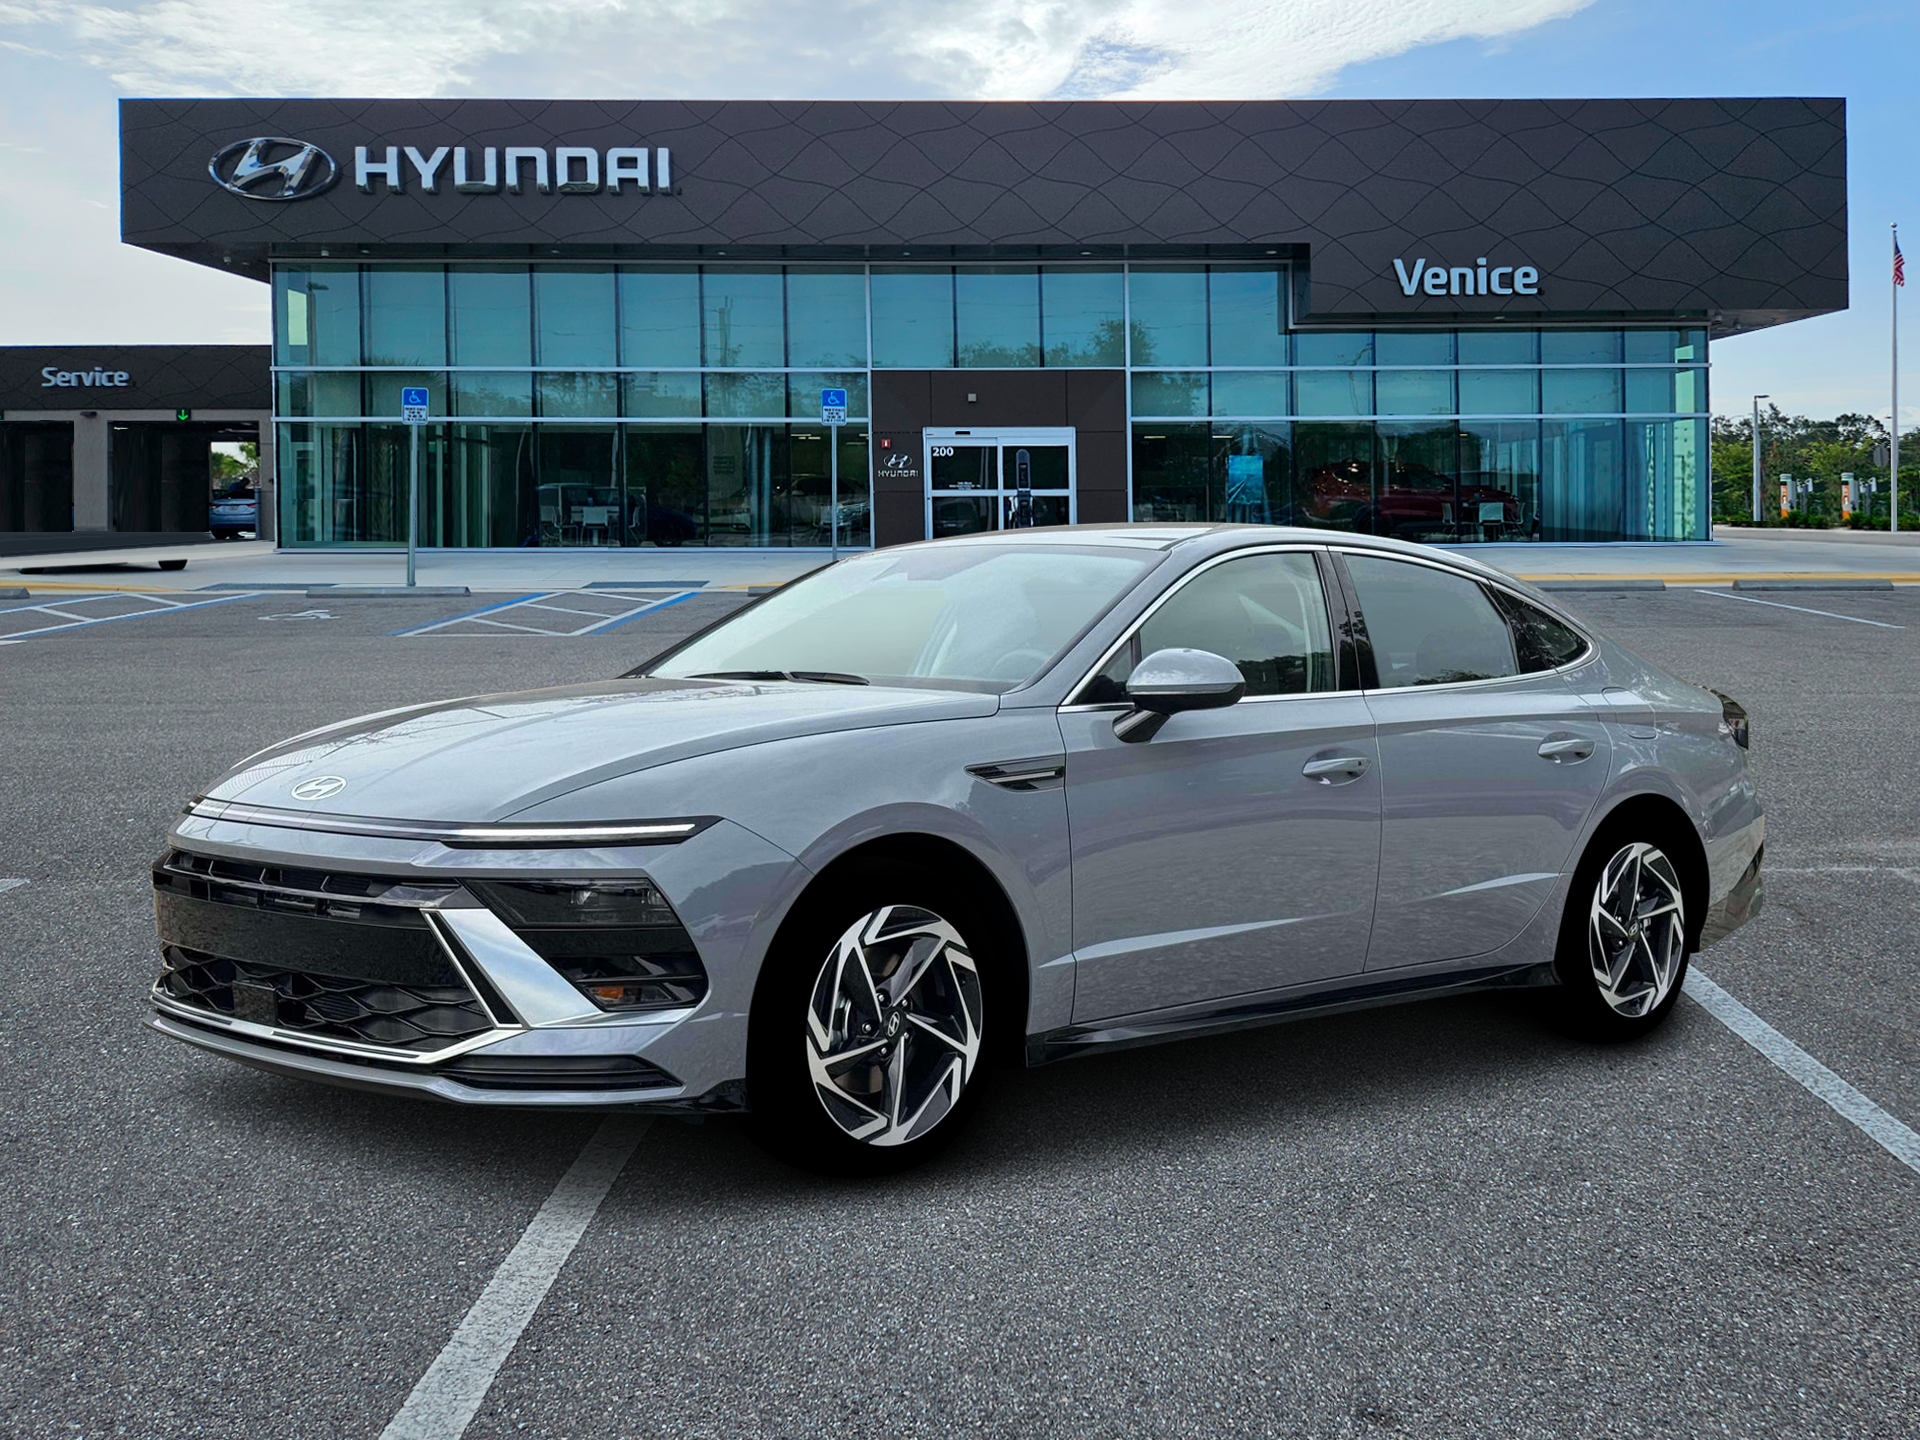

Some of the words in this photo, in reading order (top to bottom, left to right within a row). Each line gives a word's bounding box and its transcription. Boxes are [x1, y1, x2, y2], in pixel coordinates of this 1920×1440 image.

[355, 146, 671, 195] HYUNDAI
[1393, 257, 1539, 295] Venice
[41, 366, 130, 387] Service
[932, 447, 954, 457] 200
